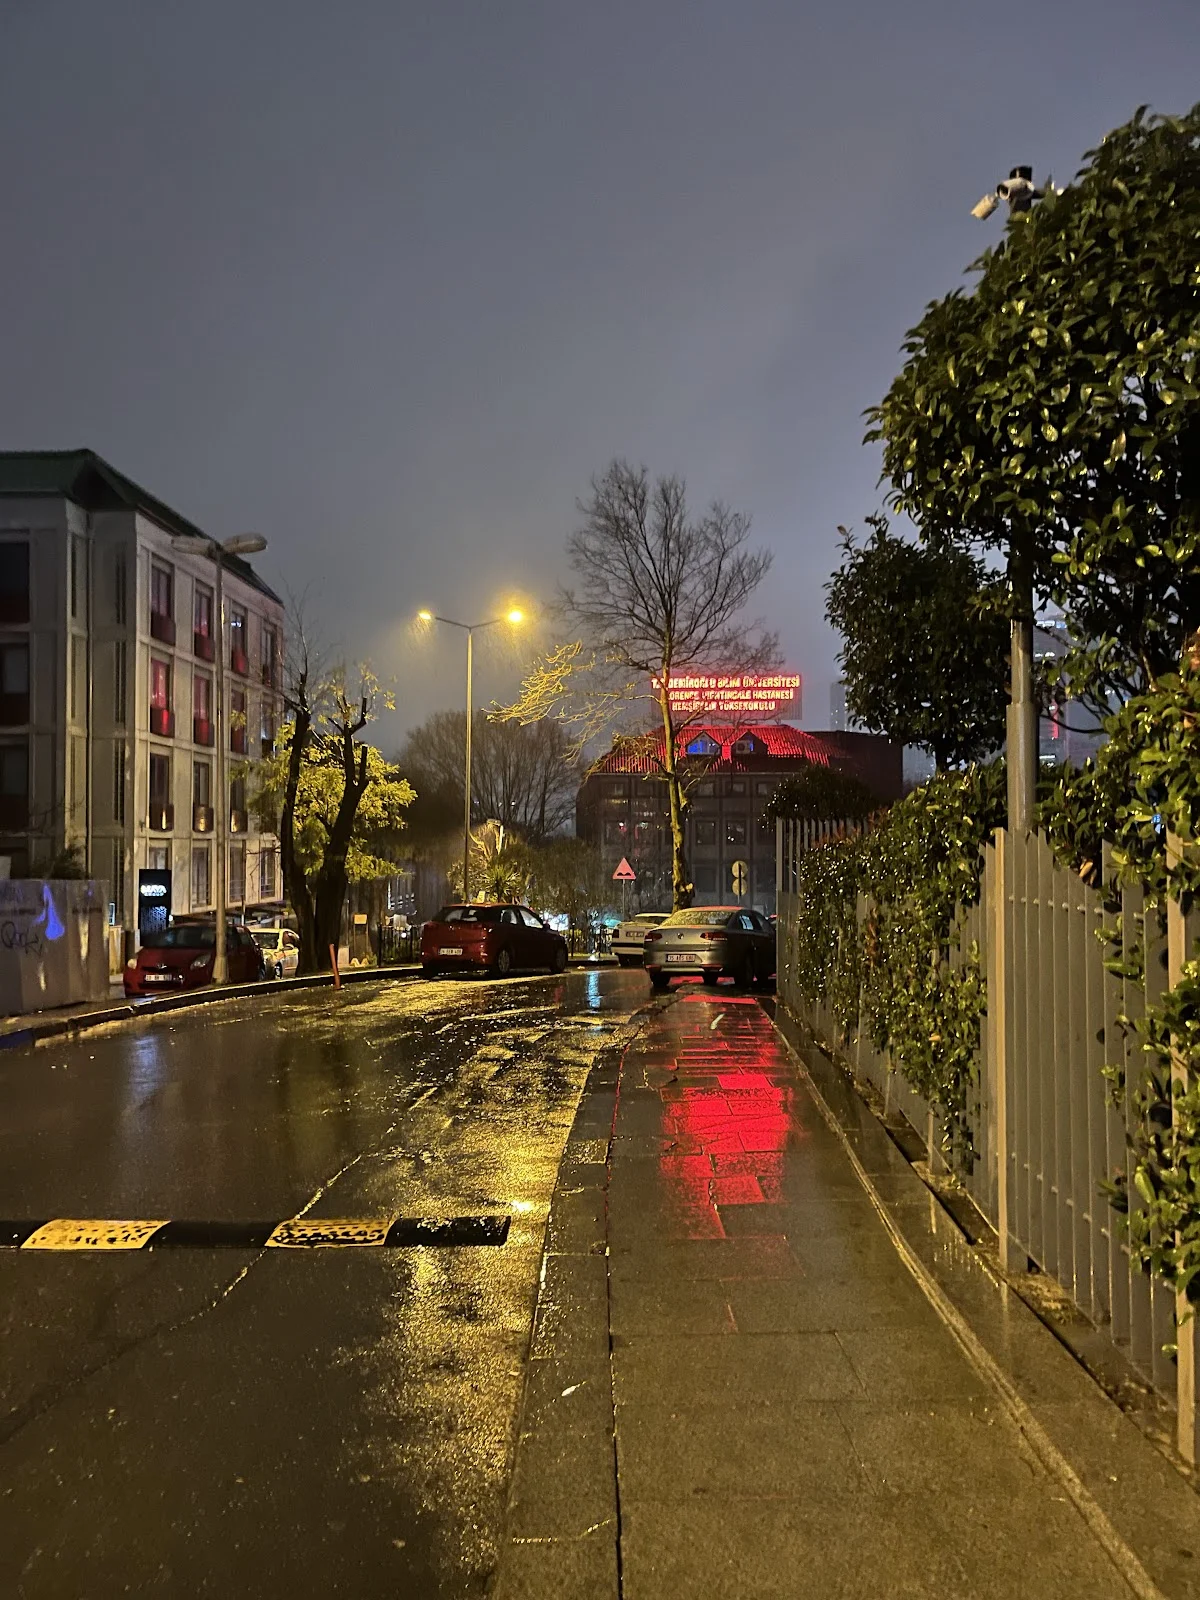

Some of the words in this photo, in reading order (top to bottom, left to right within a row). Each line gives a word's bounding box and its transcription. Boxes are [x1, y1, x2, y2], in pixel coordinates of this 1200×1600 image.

[717, 676, 741, 688] BİLİM
[742, 674, 800, 688] ÜNİVERSİTESİ
[668, 690, 699, 701] ORENCE
[752, 688, 794, 700] HASTANESİ
[718, 700, 775, 711] YÜKSEKOKULU
